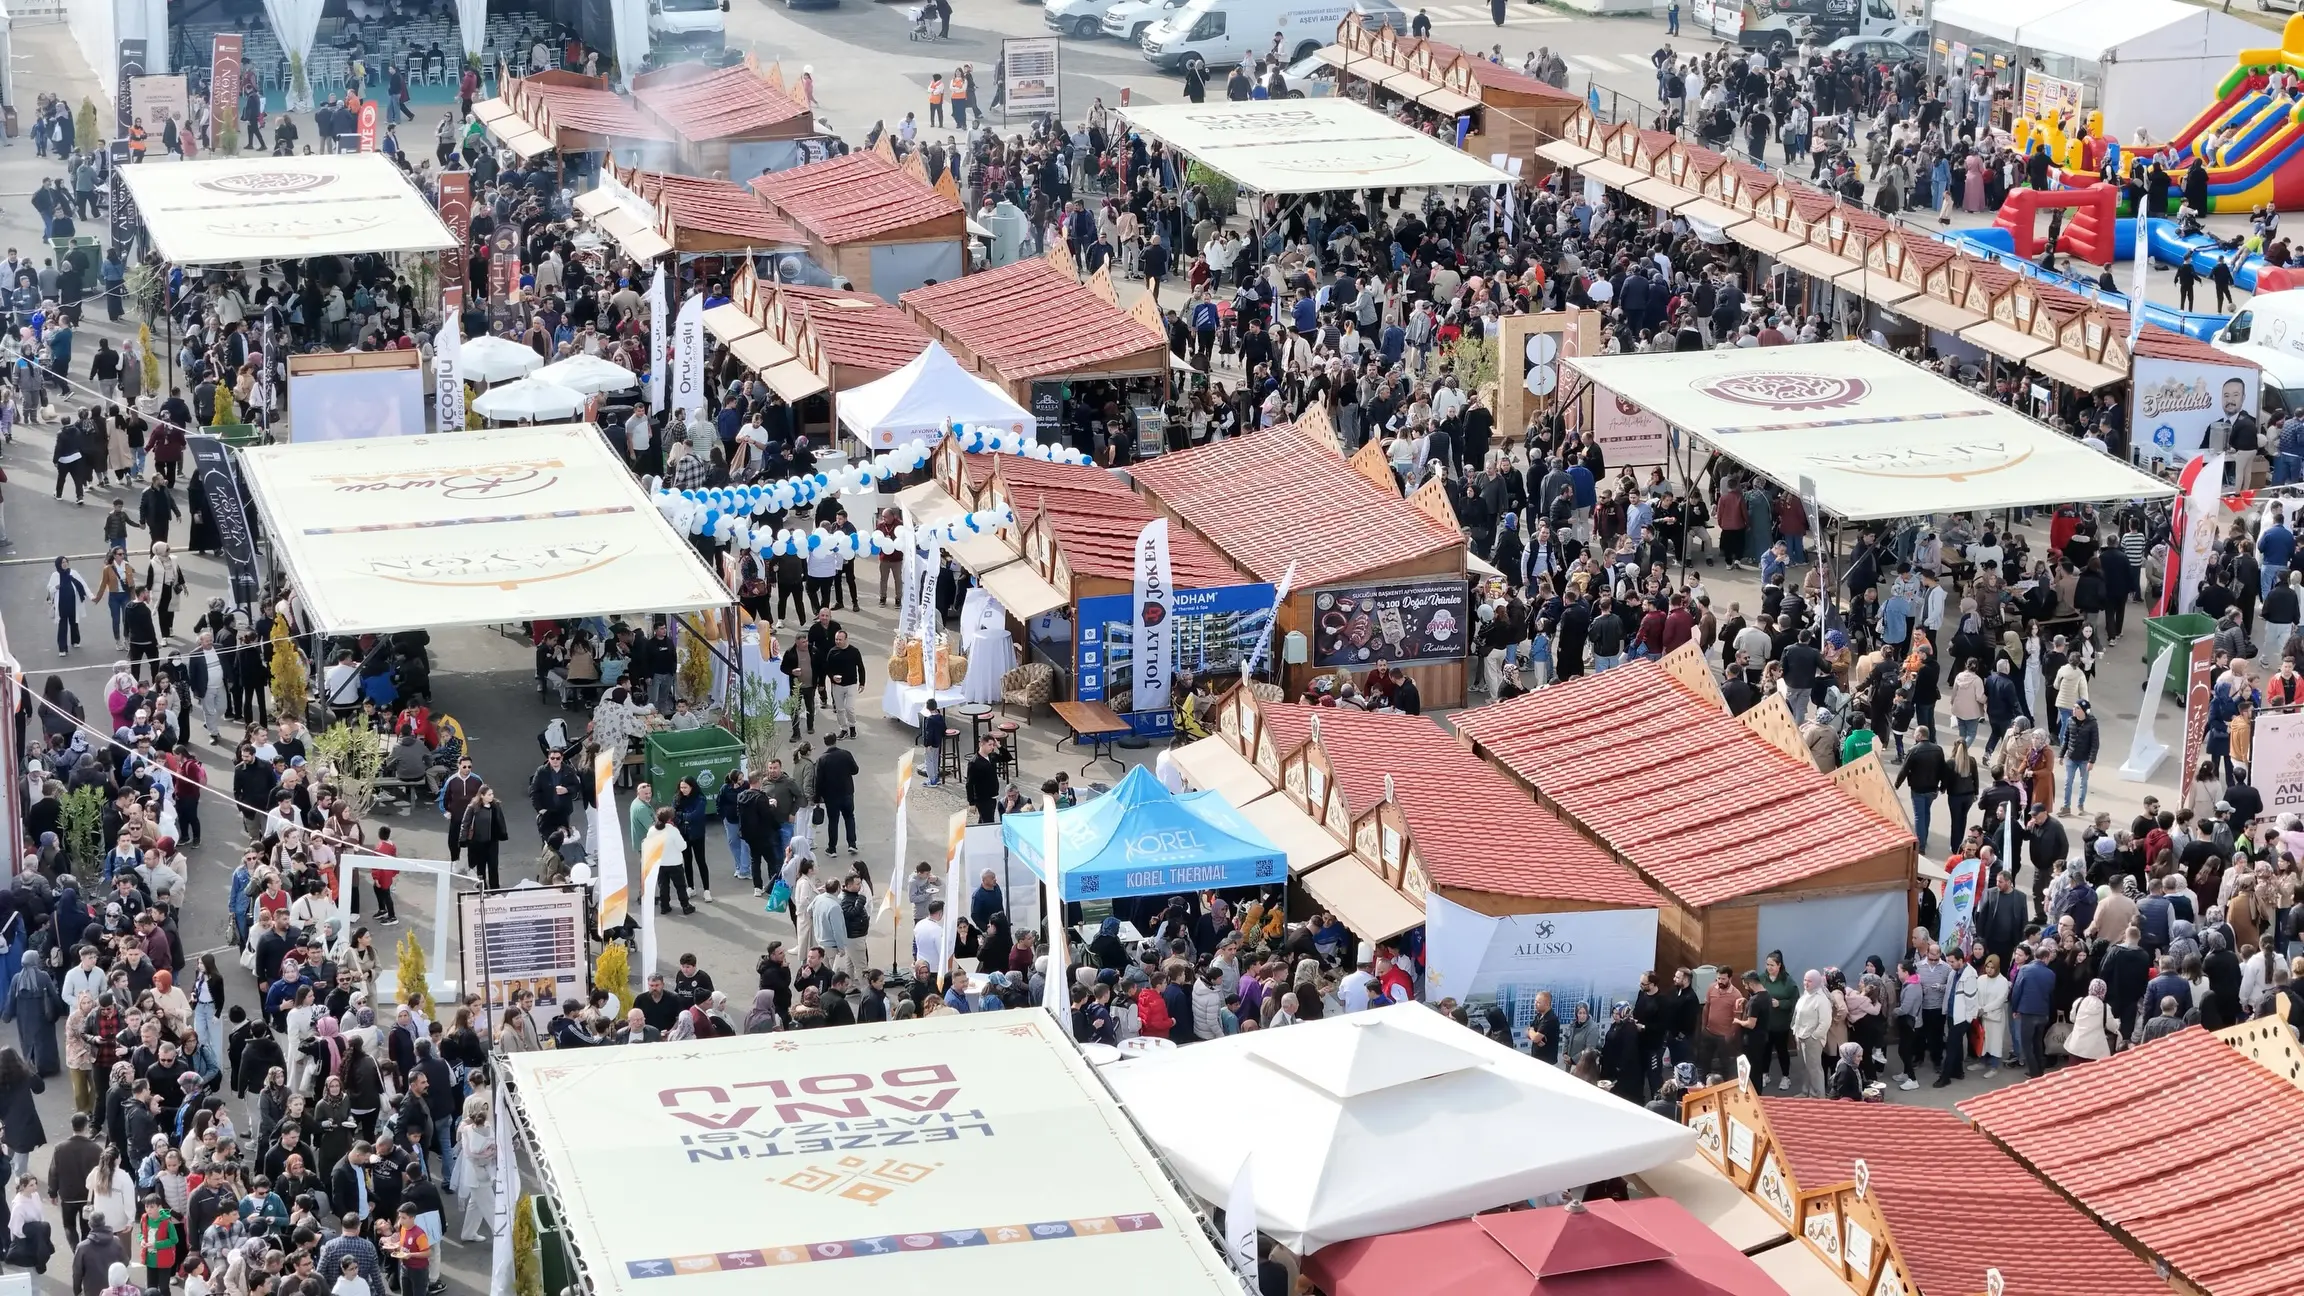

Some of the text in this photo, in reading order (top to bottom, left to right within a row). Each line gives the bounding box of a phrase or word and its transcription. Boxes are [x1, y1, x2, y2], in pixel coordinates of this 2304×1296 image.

[494, 252, 505, 297] MHD
[680, 321, 694, 395] Oruçoğlu
[440, 360, 457, 432] uçoğlu
[1145, 537, 1164, 690] JOLLY JOKER
[1172, 593, 1216, 606] NDHAM
[1386, 600, 1400, 608] 100
[1402, 596, 1428, 610] Doğal
[1124, 829, 1206, 864] KOREL
[1126, 864, 1228, 888] KOREL THERMAL
[1514, 942, 1573, 955] ALUSSO
[657, 1063, 958, 1108] DOLU
[669, 1087, 962, 1130] ANA
[679, 1109, 986, 1146] HAFIZASI
